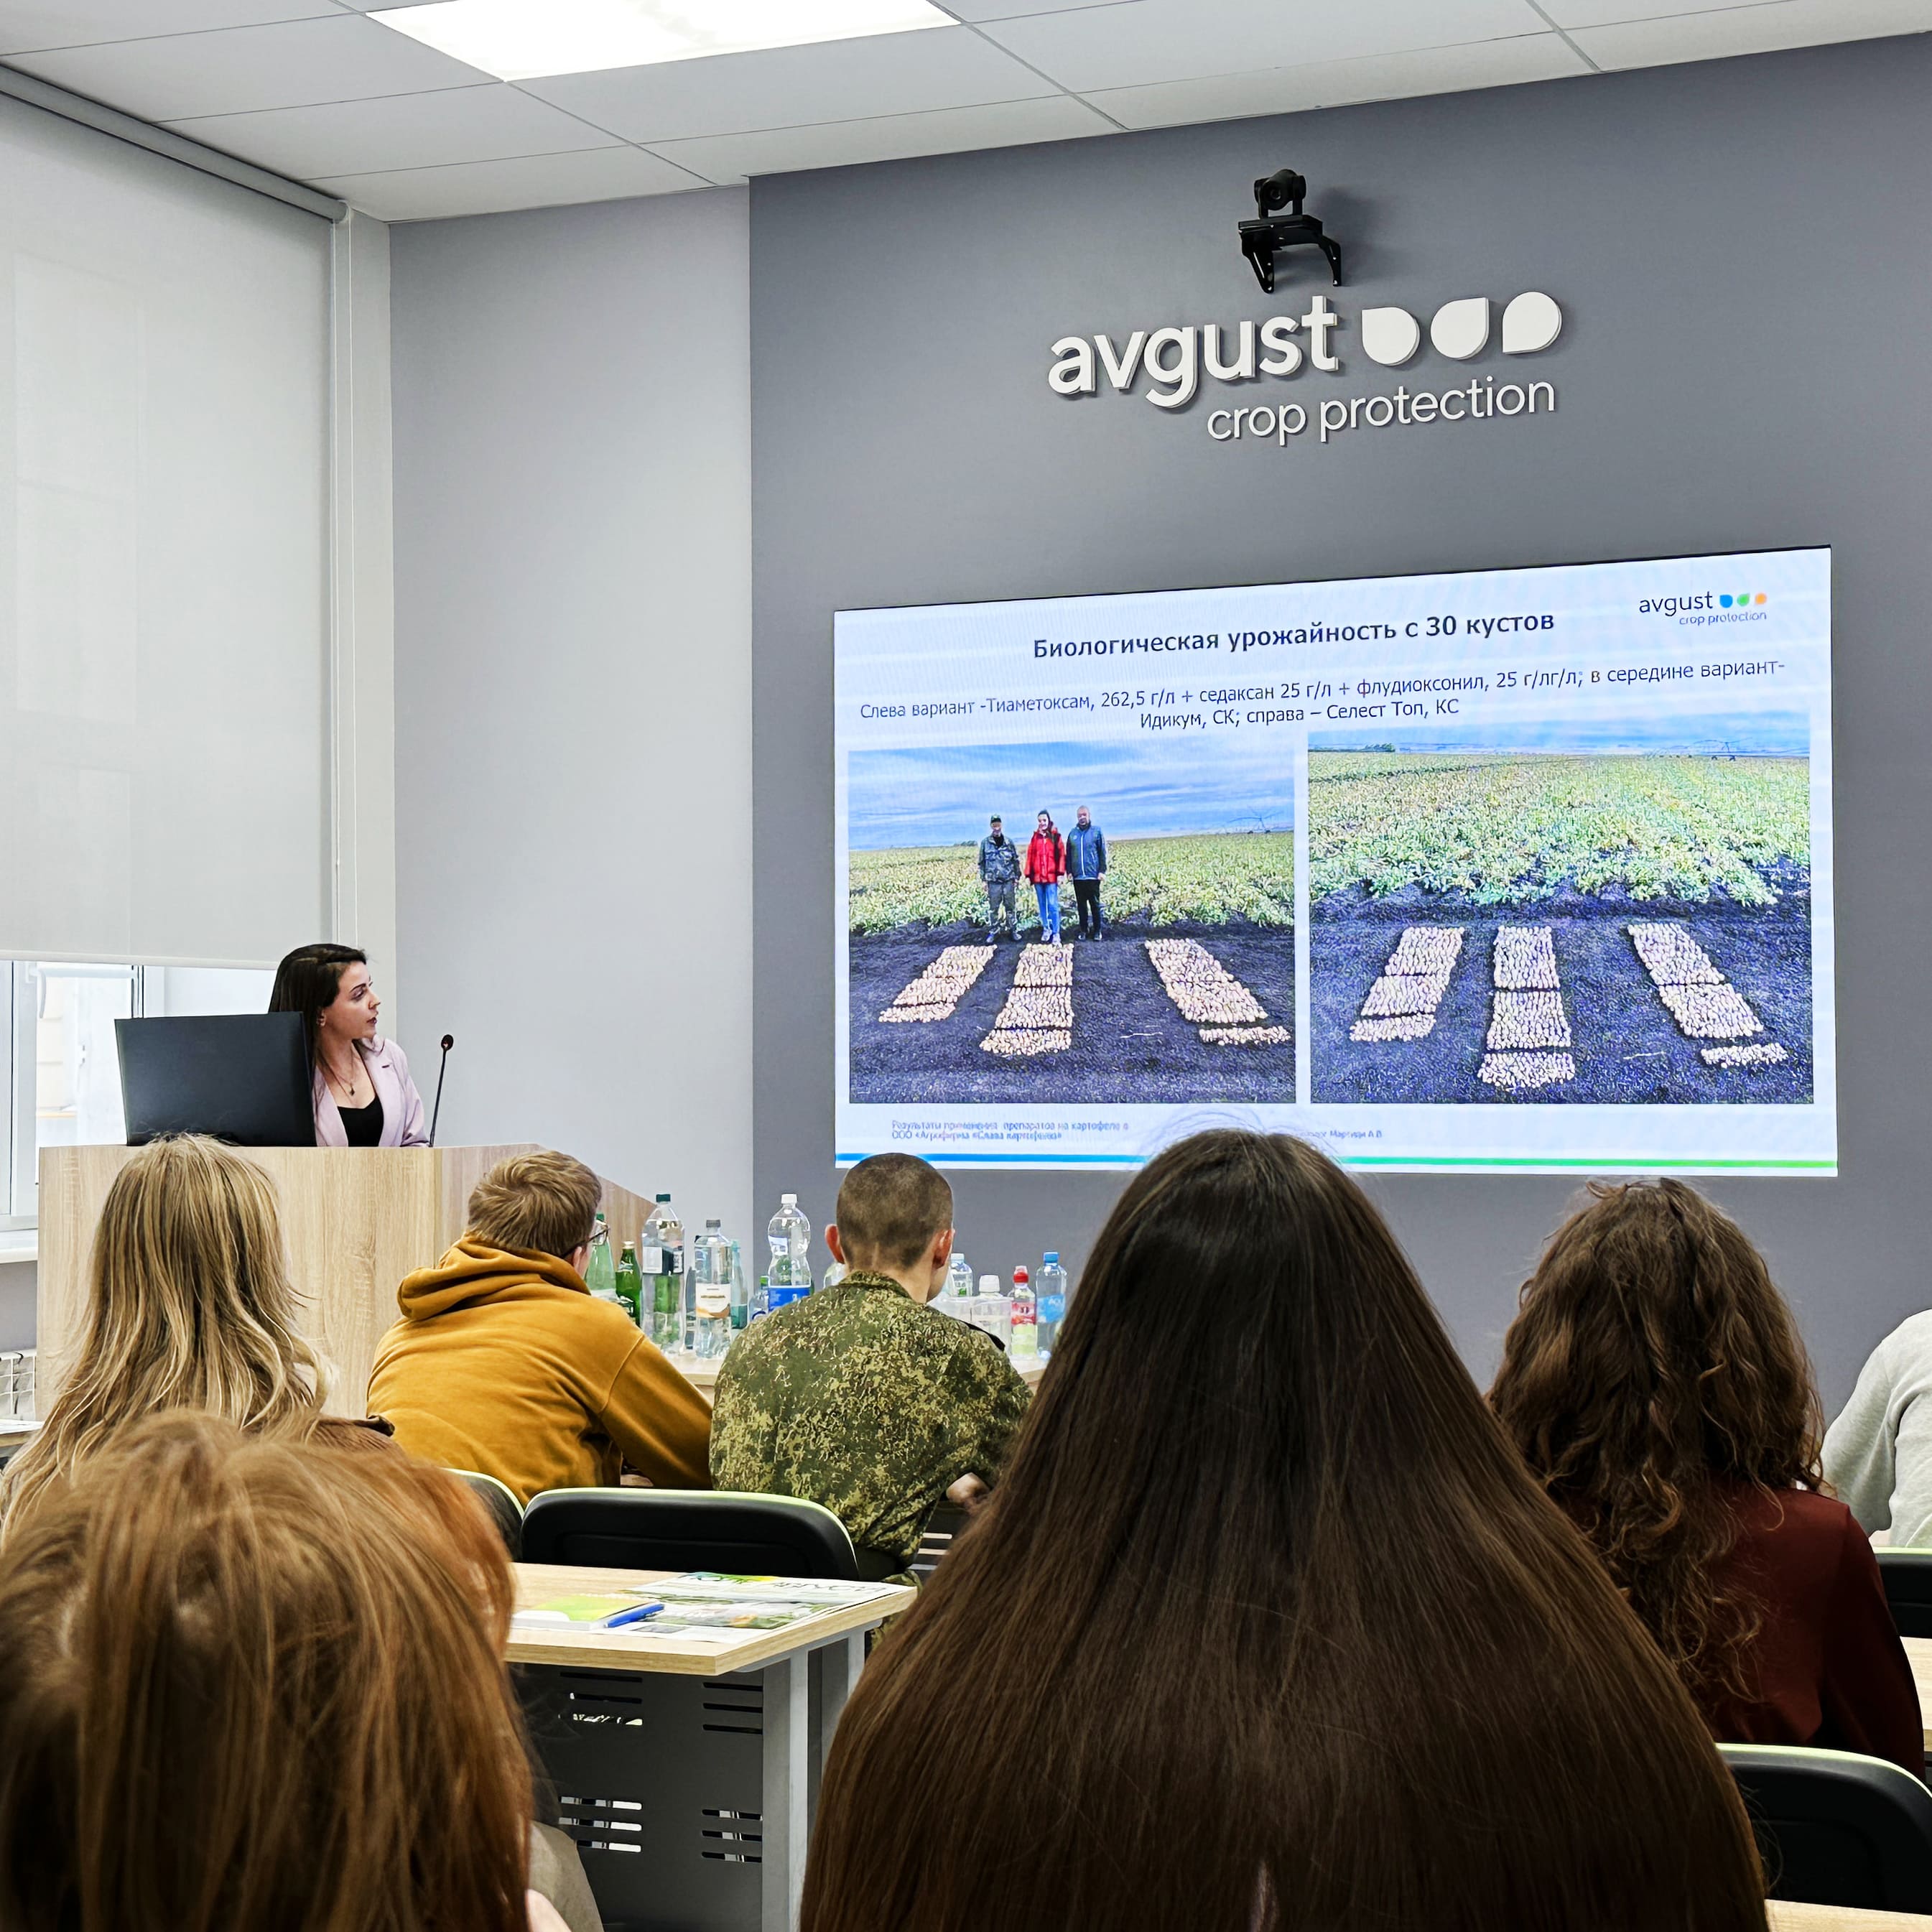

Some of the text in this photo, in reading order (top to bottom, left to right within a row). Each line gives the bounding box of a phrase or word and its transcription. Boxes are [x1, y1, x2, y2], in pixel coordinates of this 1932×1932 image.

[1046, 294, 1340, 409] avgust
[1207, 374, 1556, 447] crop protection
[1638, 590, 1714, 617] avgust
[1679, 616, 1706, 626] crop
[1034, 614, 1554, 659] Биологическая урожайность с 30 кустов
[860, 704, 906, 718] Слева
[912, 701, 975, 718] вариант
[1100, 690, 1146, 710] 262,5
[1151, 688, 1175, 708] г/л
[1199, 685, 1275, 705] седаксан
[1281, 682, 1301, 699] 25
[1306, 681, 1332, 700] г/л
[1357, 675, 1490, 699] флудиоксонил,
[1496, 671, 1518, 688] 25
[1523, 668, 1584, 689] г/лг/л;
[1590, 671, 1601, 683] в
[1607, 664, 1694, 685] середине
[1700, 659, 1785, 680] вариант-
[1140, 712, 1207, 730] Идикум,
[1212, 708, 1241, 727] СК;
[1246, 708, 1305, 726] справа
[1327, 704, 1387, 719] Селест
[1390, 700, 1429, 719] Топ,
[1436, 698, 1460, 715] КС
